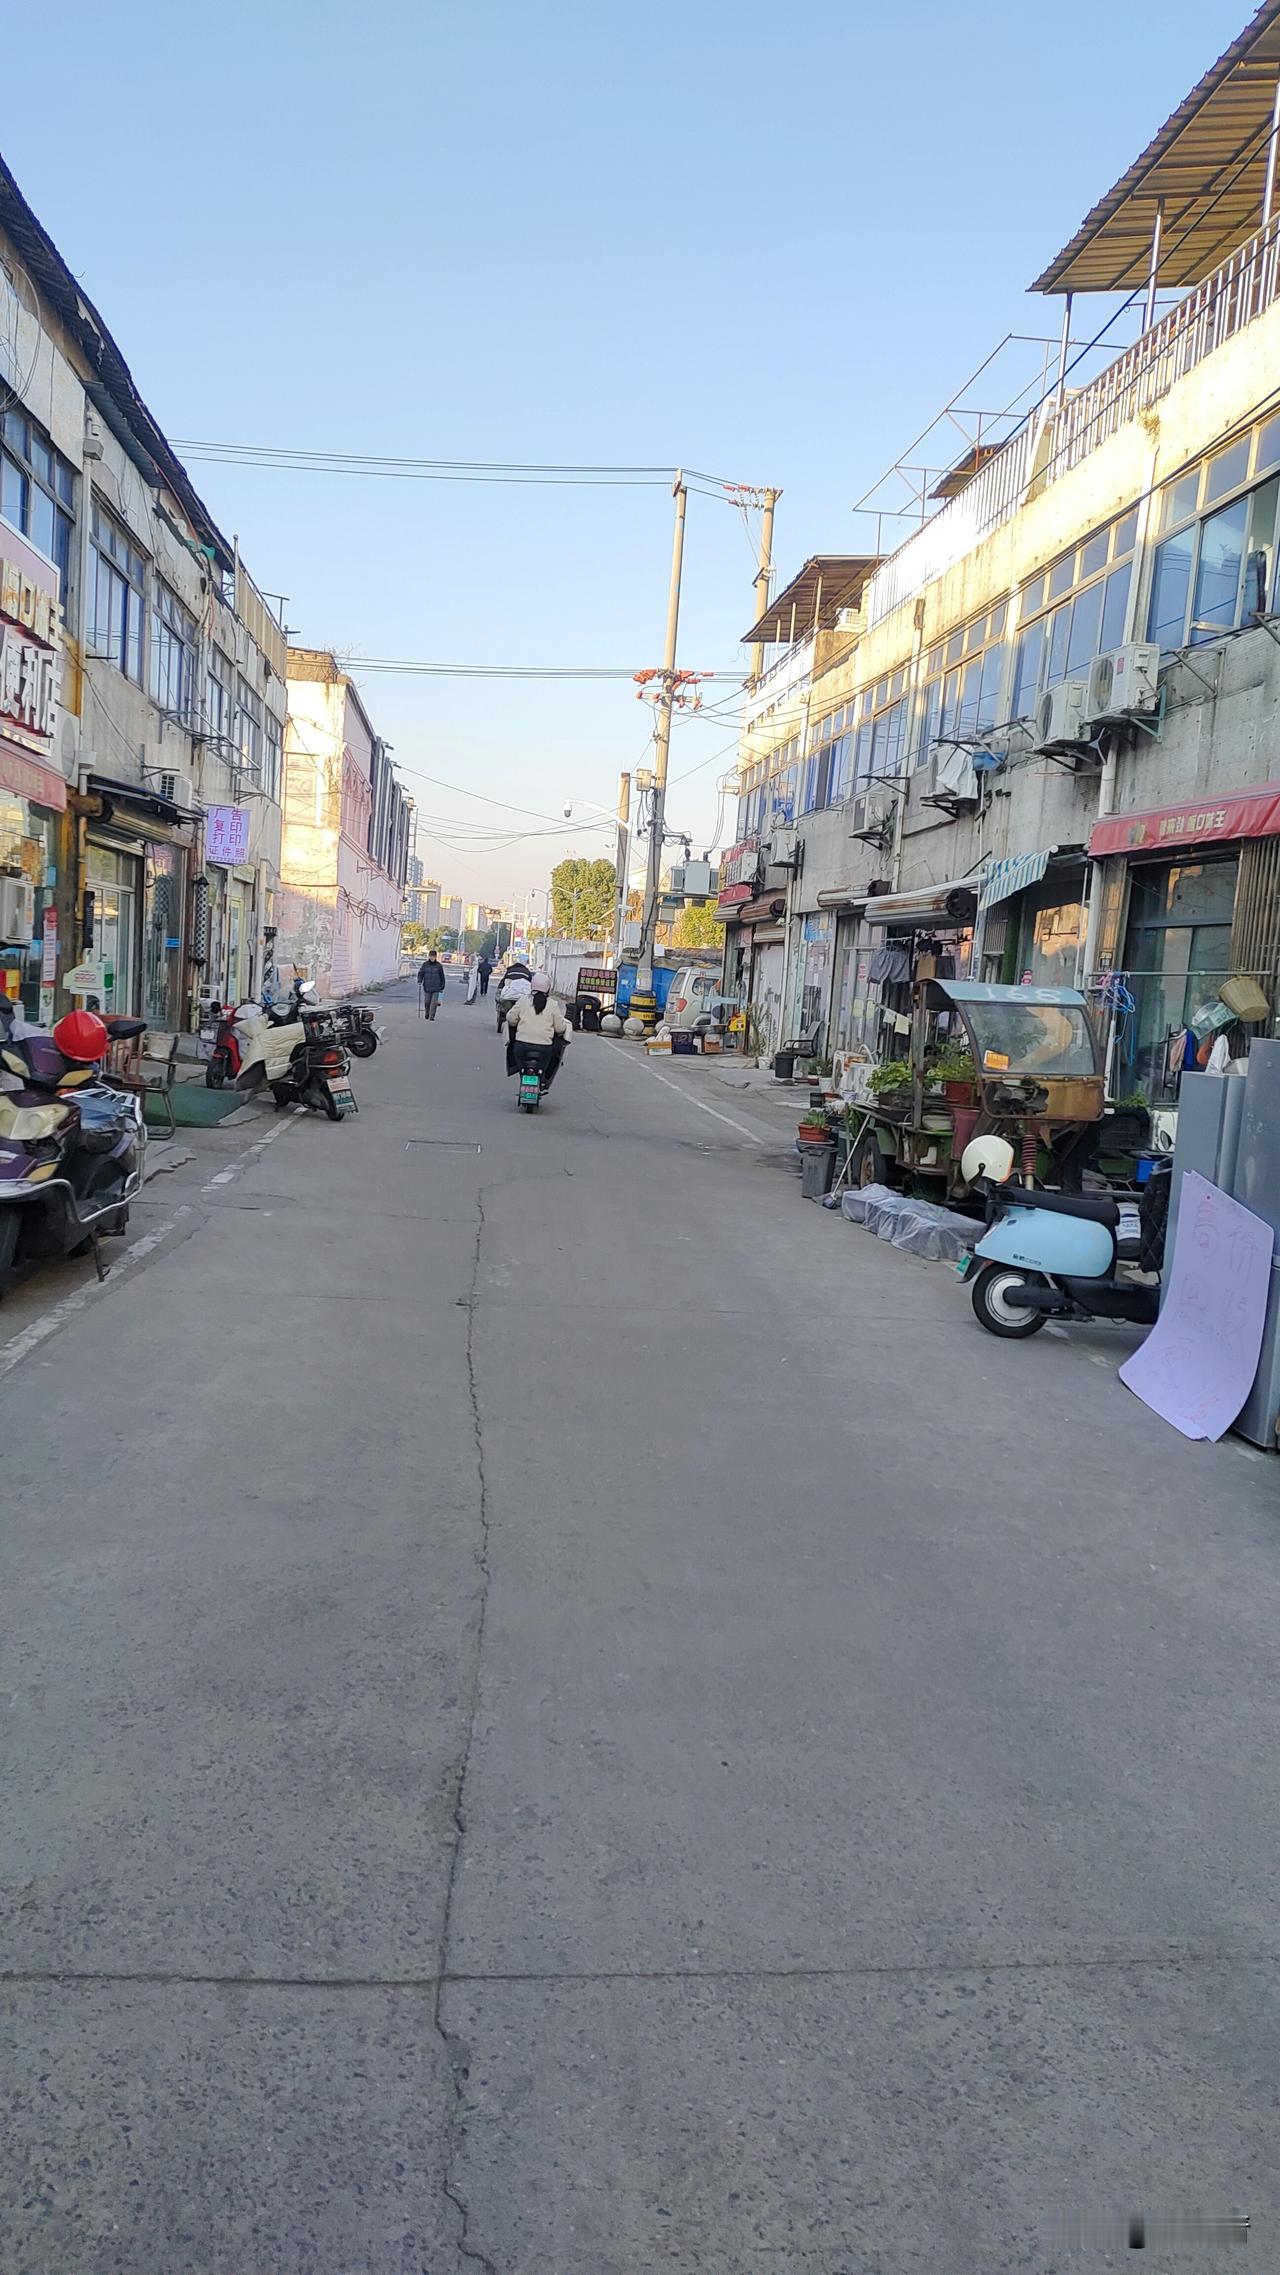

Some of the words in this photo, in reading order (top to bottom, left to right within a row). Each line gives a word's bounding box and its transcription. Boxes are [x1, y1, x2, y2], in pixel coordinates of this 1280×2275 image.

[0, 625, 63, 739] 便利店
[214, 808, 243, 821] 广告
[213, 820, 242, 834] 复印
[211, 832, 241, 846] 打印
[208, 845, 246, 858] 证件照
